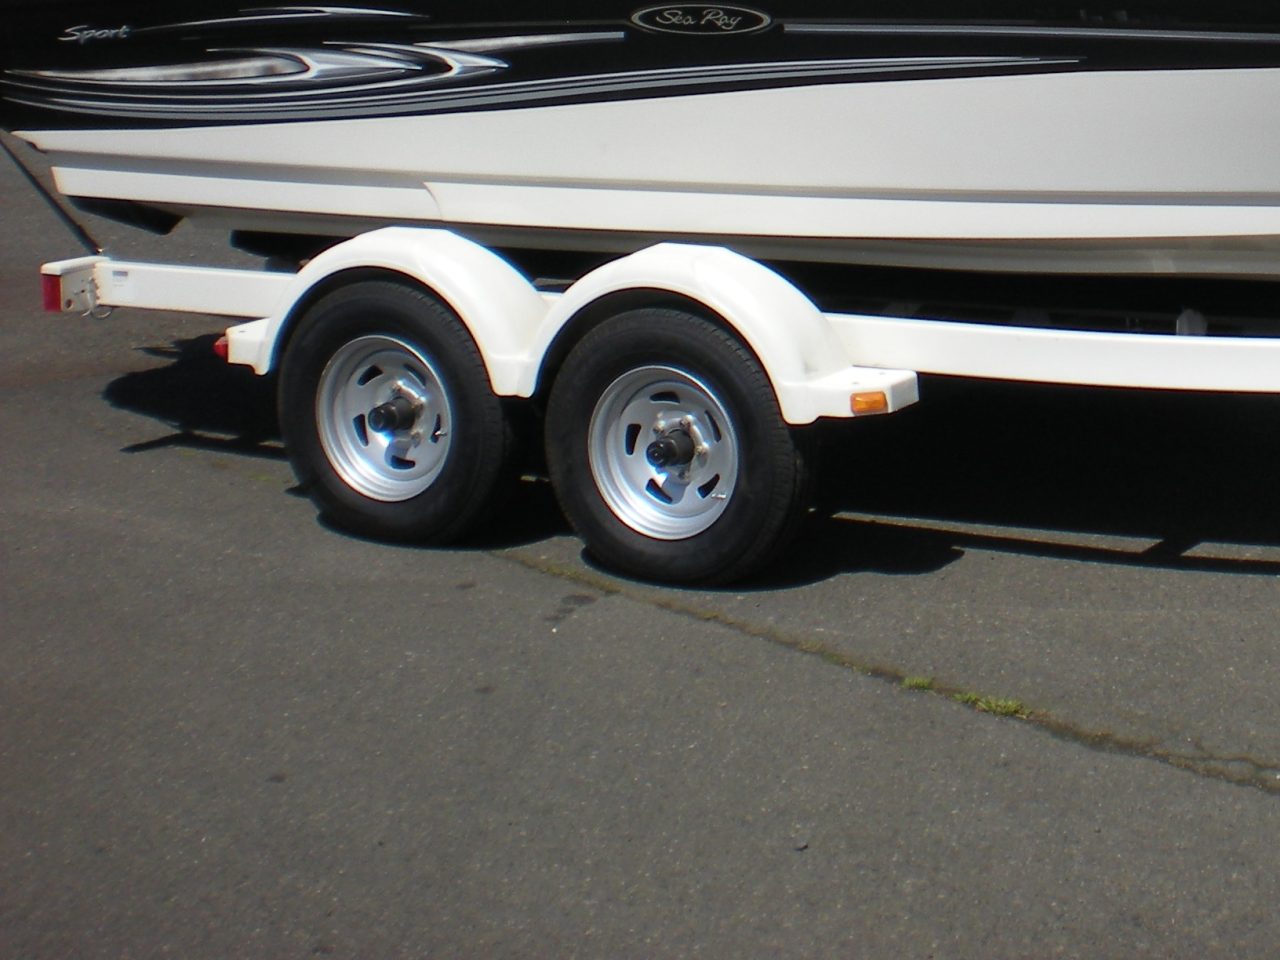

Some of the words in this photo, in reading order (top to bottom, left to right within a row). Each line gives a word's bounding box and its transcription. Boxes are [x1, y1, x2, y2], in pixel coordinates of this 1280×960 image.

[655, 9, 697, 25] Sea
[700, 8, 742, 30] Ray
[57, 25, 130, 44] Sport
